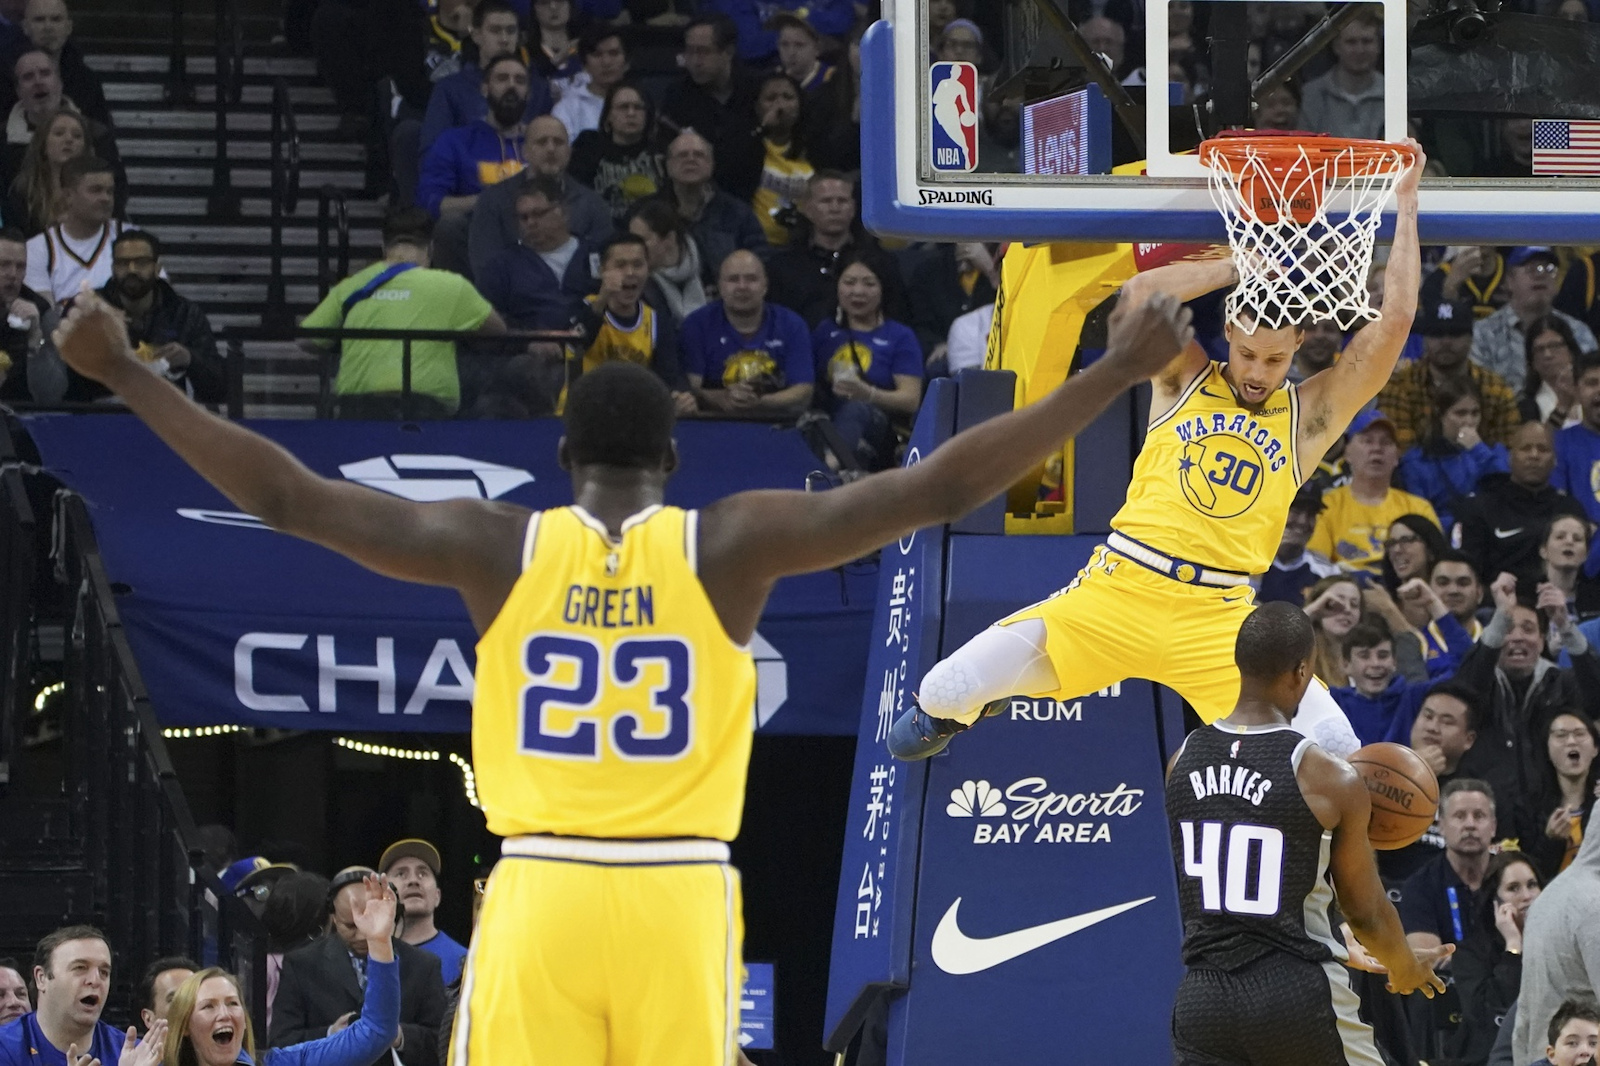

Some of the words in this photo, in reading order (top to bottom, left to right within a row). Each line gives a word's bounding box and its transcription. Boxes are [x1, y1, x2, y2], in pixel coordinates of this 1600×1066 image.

[937, 147, 960, 166] NBA
[918, 189, 993, 206] SPALDING
[1260, 197, 1312, 211] SPAING
[1253, 405, 1288, 417] Rakuten
[1175, 413, 1287, 472] WARRIORS
[1208, 451, 1261, 496] 30
[563, 584, 655, 628] GREEN
[896, 566, 915, 712] MOUTAI
[234, 632, 477, 715] CHA
[518, 630, 694, 763] 23
[1010, 701, 1083, 721] RUM
[1005, 777, 1144, 829] Sports
[1189, 764, 1273, 806] BARNES
[1363, 775, 1415, 810] LDING
[871, 755, 896, 938] KWEICHO
[973, 823, 1030, 844] BAY
[1034, 822, 1111, 843] AREA
[1180, 820, 1284, 916] 40
